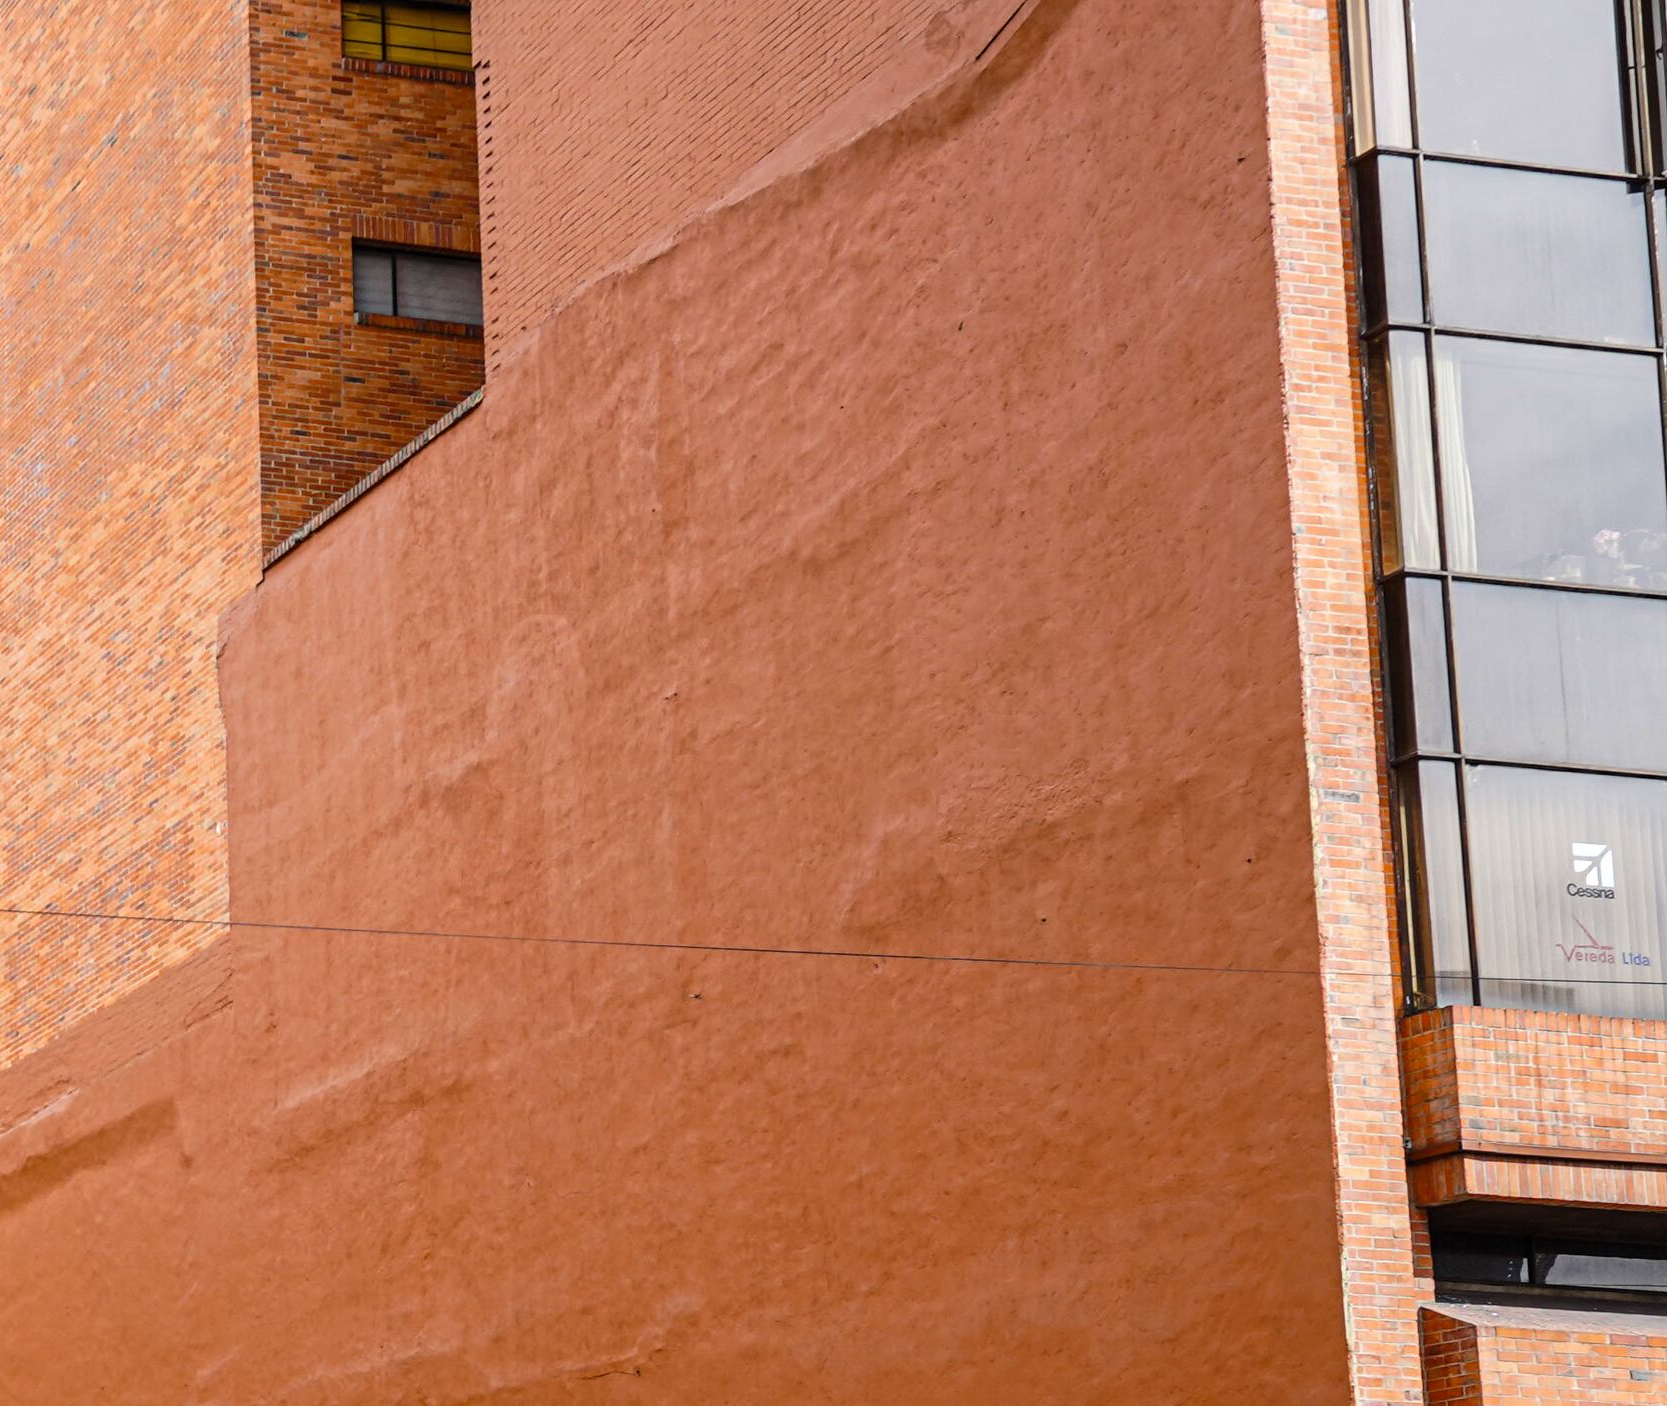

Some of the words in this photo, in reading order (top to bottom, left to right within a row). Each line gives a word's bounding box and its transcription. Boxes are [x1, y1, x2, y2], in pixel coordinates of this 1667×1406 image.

[1567, 883, 1615, 899] Cessna
[1555, 943, 1616, 965] Vereda
[1622, 952, 1651, 967] Ltda
